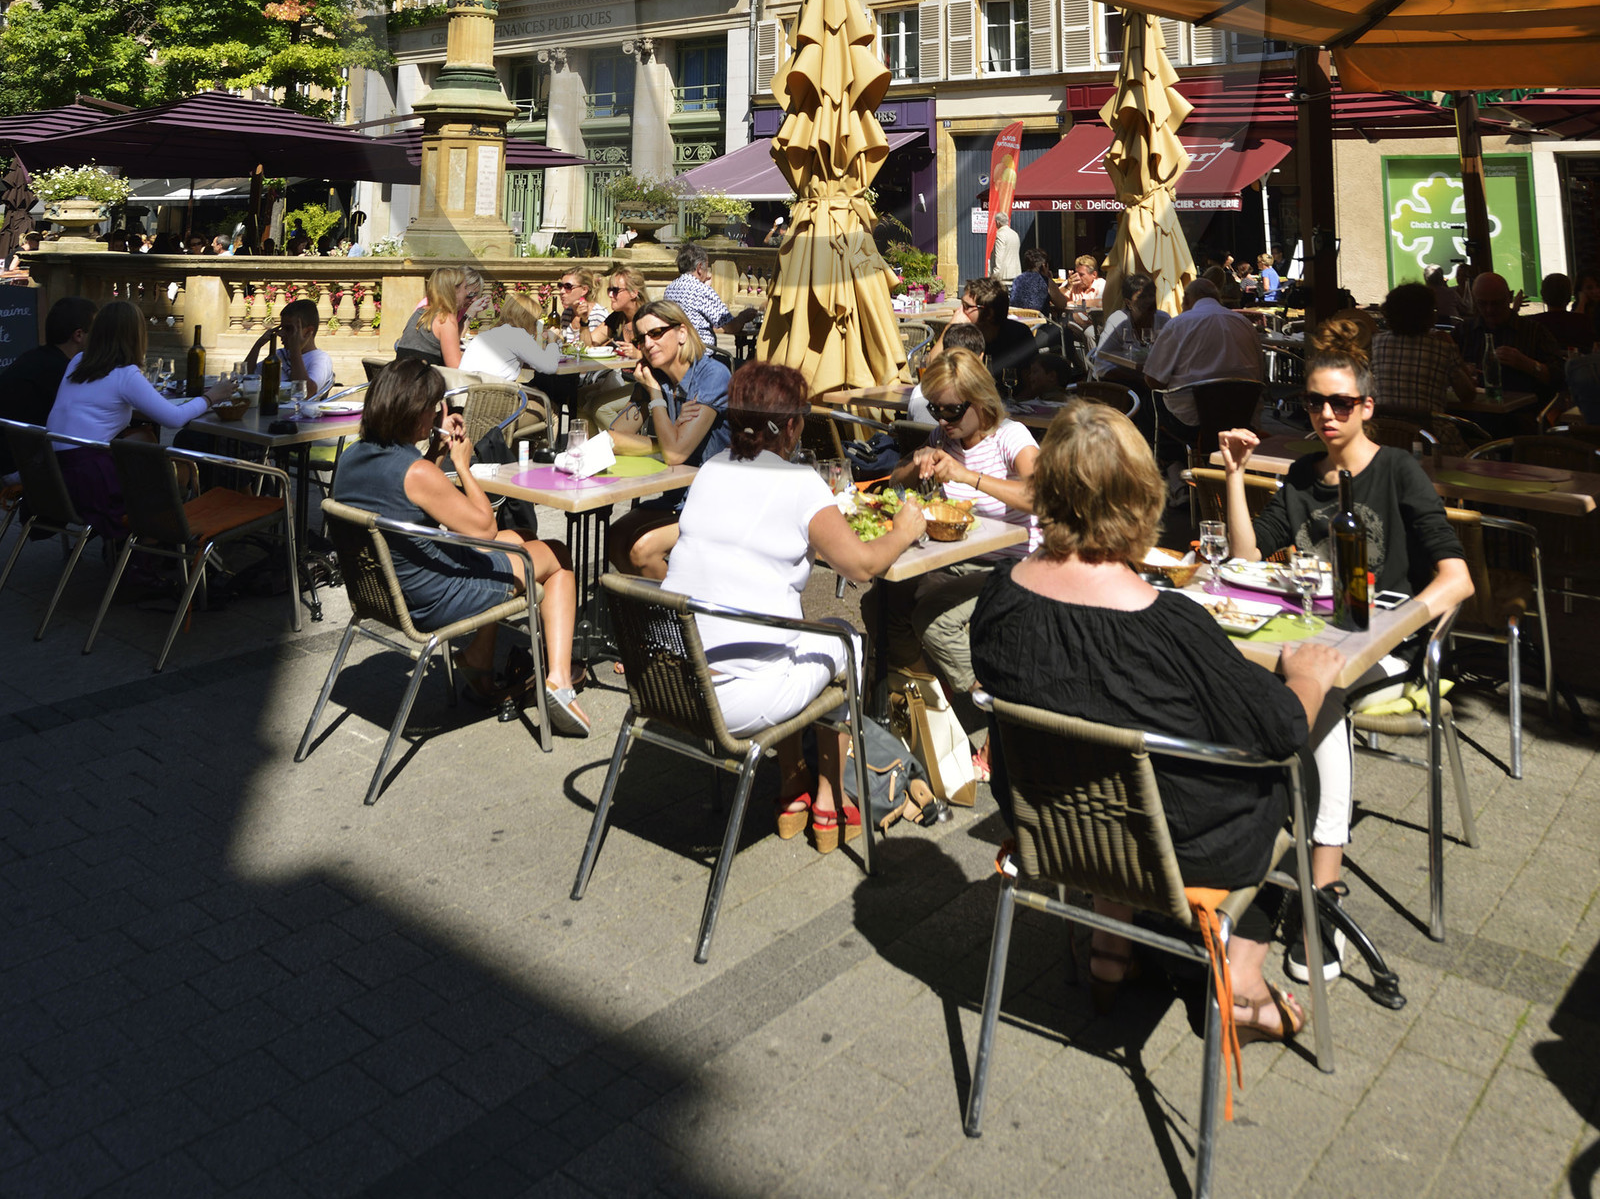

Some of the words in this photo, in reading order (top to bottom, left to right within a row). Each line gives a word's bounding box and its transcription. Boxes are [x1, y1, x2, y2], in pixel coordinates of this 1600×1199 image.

[549, 11, 612, 31] PUBLIQUES
[1052, 200, 1072, 210] Diet
[1075, 201, 1084, 210] &
[1199, 199, 1240, 208] CREPERIE
